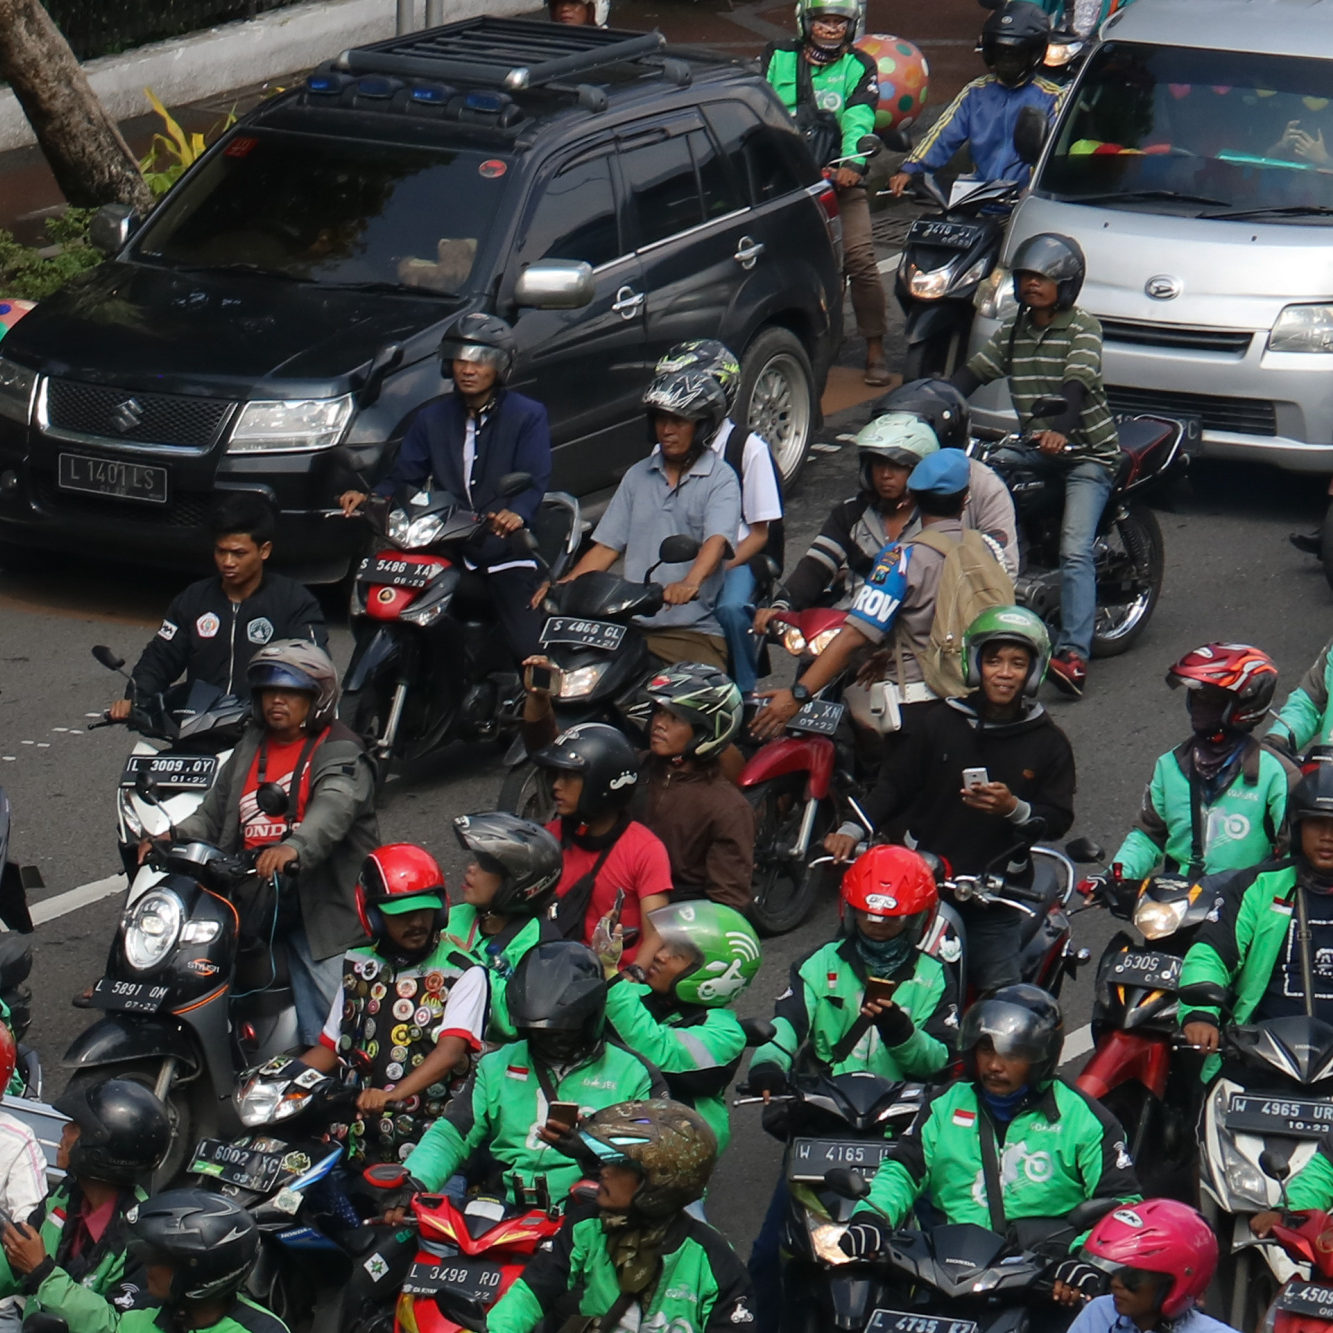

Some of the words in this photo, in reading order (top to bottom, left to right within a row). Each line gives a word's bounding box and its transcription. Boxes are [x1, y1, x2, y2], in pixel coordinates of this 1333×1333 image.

[70, 458, 80, 480] L
[88, 460, 126, 487] 1401
[133, 467, 154, 490] LS
[359, 558, 369, 570] S
[553, 620, 564, 631] S
[132, 759, 140, 772] L
[150, 760, 184, 773] 3009
[95, 979, 103, 992] L
[111, 981, 143, 996] 5891
[1235, 1099, 1246, 1112] W
[1261, 1101, 1300, 1118] 4965
[215, 1146, 249, 1165] 6002
[800, 1145, 810, 1159] W
[825, 1147, 864, 1162] 4165
[410, 1266, 418, 1278] L
[430, 1267, 468, 1284] 3498
[479, 1271, 500, 1287] RD
[875, 1313, 883, 1327] L
